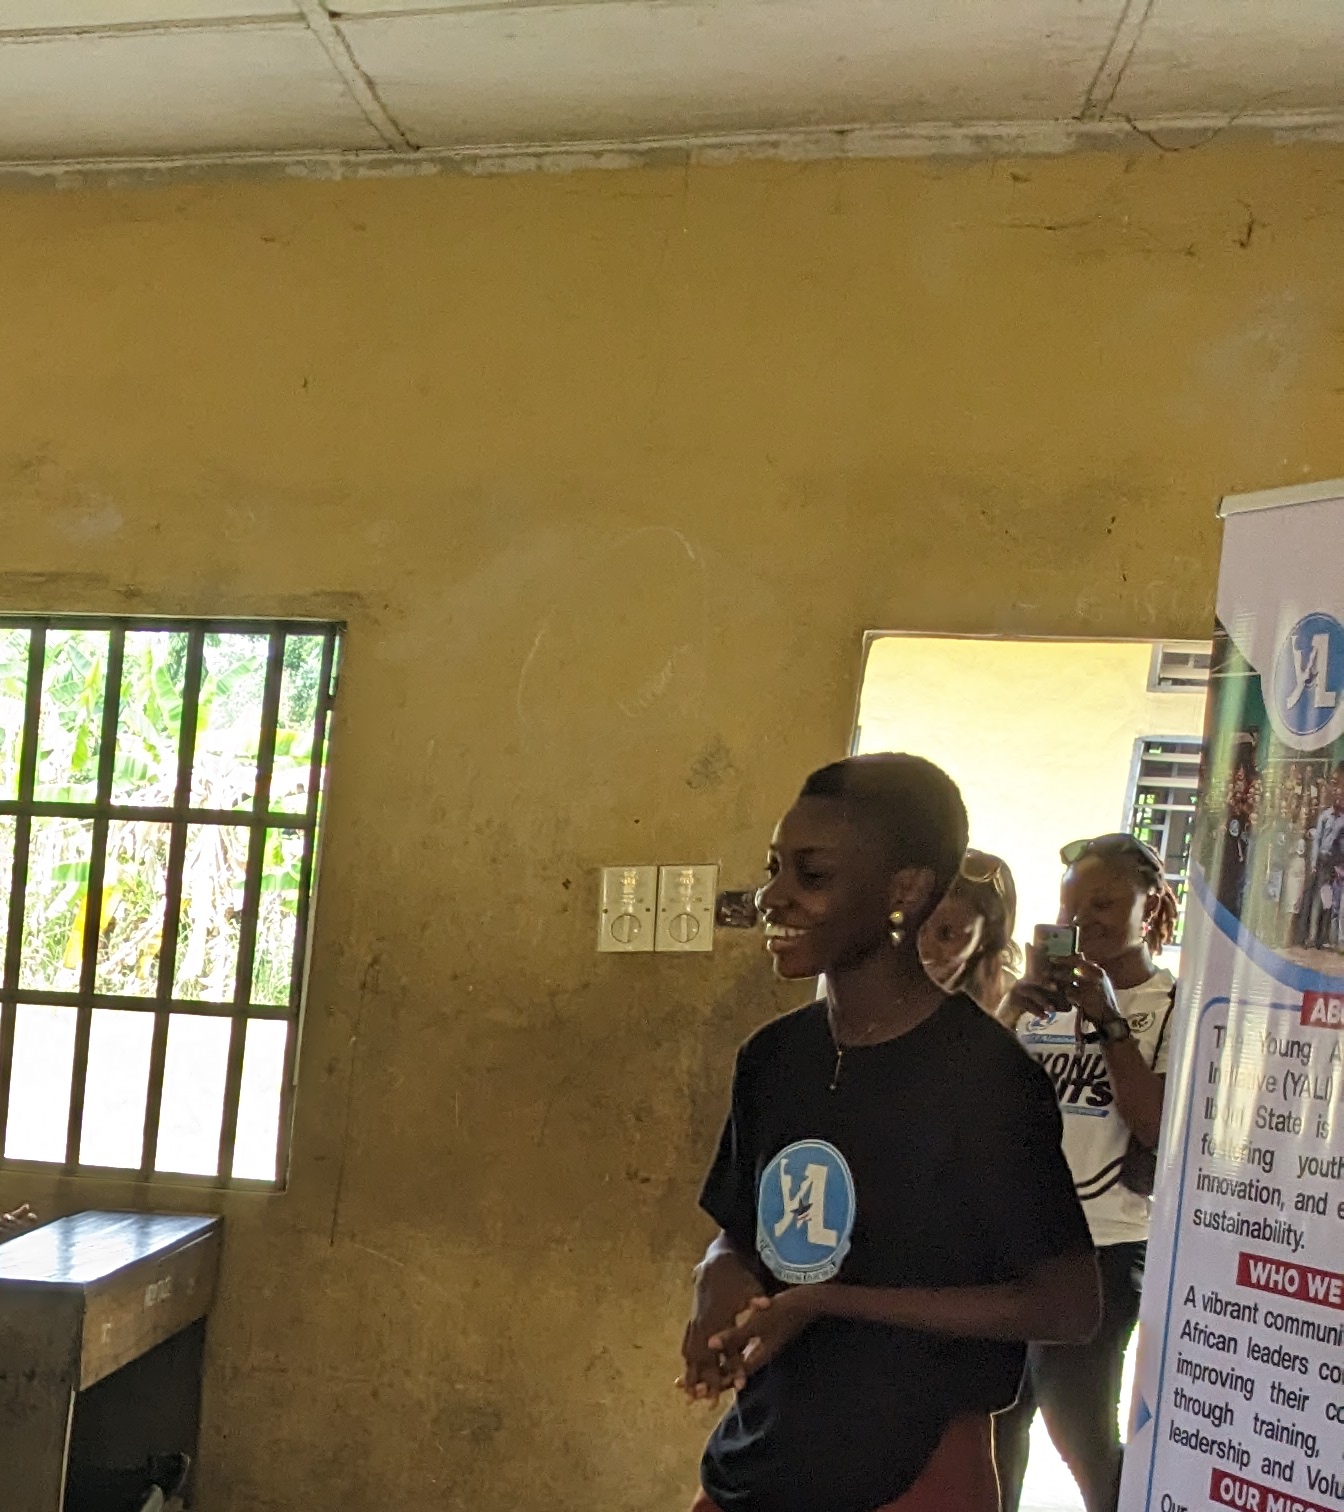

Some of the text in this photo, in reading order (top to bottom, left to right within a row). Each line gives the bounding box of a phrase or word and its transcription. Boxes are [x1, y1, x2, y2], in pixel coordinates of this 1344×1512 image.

[1310, 998, 1344, 1023] AB
[1260, 1032, 1312, 1066] Young
[1255, 1105, 1303, 1135] State
[1316, 1114, 1329, 1138] is
[1197, 1168, 1285, 1211] innovation,
[1294, 1192, 1328, 1216] and
[1193, 1208, 1304, 1253] sustainability.
[1249, 1259, 1343, 1304] WHO WE
[1184, 1285, 1196, 1308] A
[1202, 1291, 1259, 1324] vibrant
[1180, 1319, 1344, 1385] African leaders co
[1176, 1352, 1255, 1401] improving
[1270, 1381, 1310, 1412] their
[1173, 1387, 1319, 1458] through training,
[1169, 1420, 1251, 1471] leadership
[1261, 1457, 1294, 1483] and
[1220, 1478, 1260, 1512] OUR
